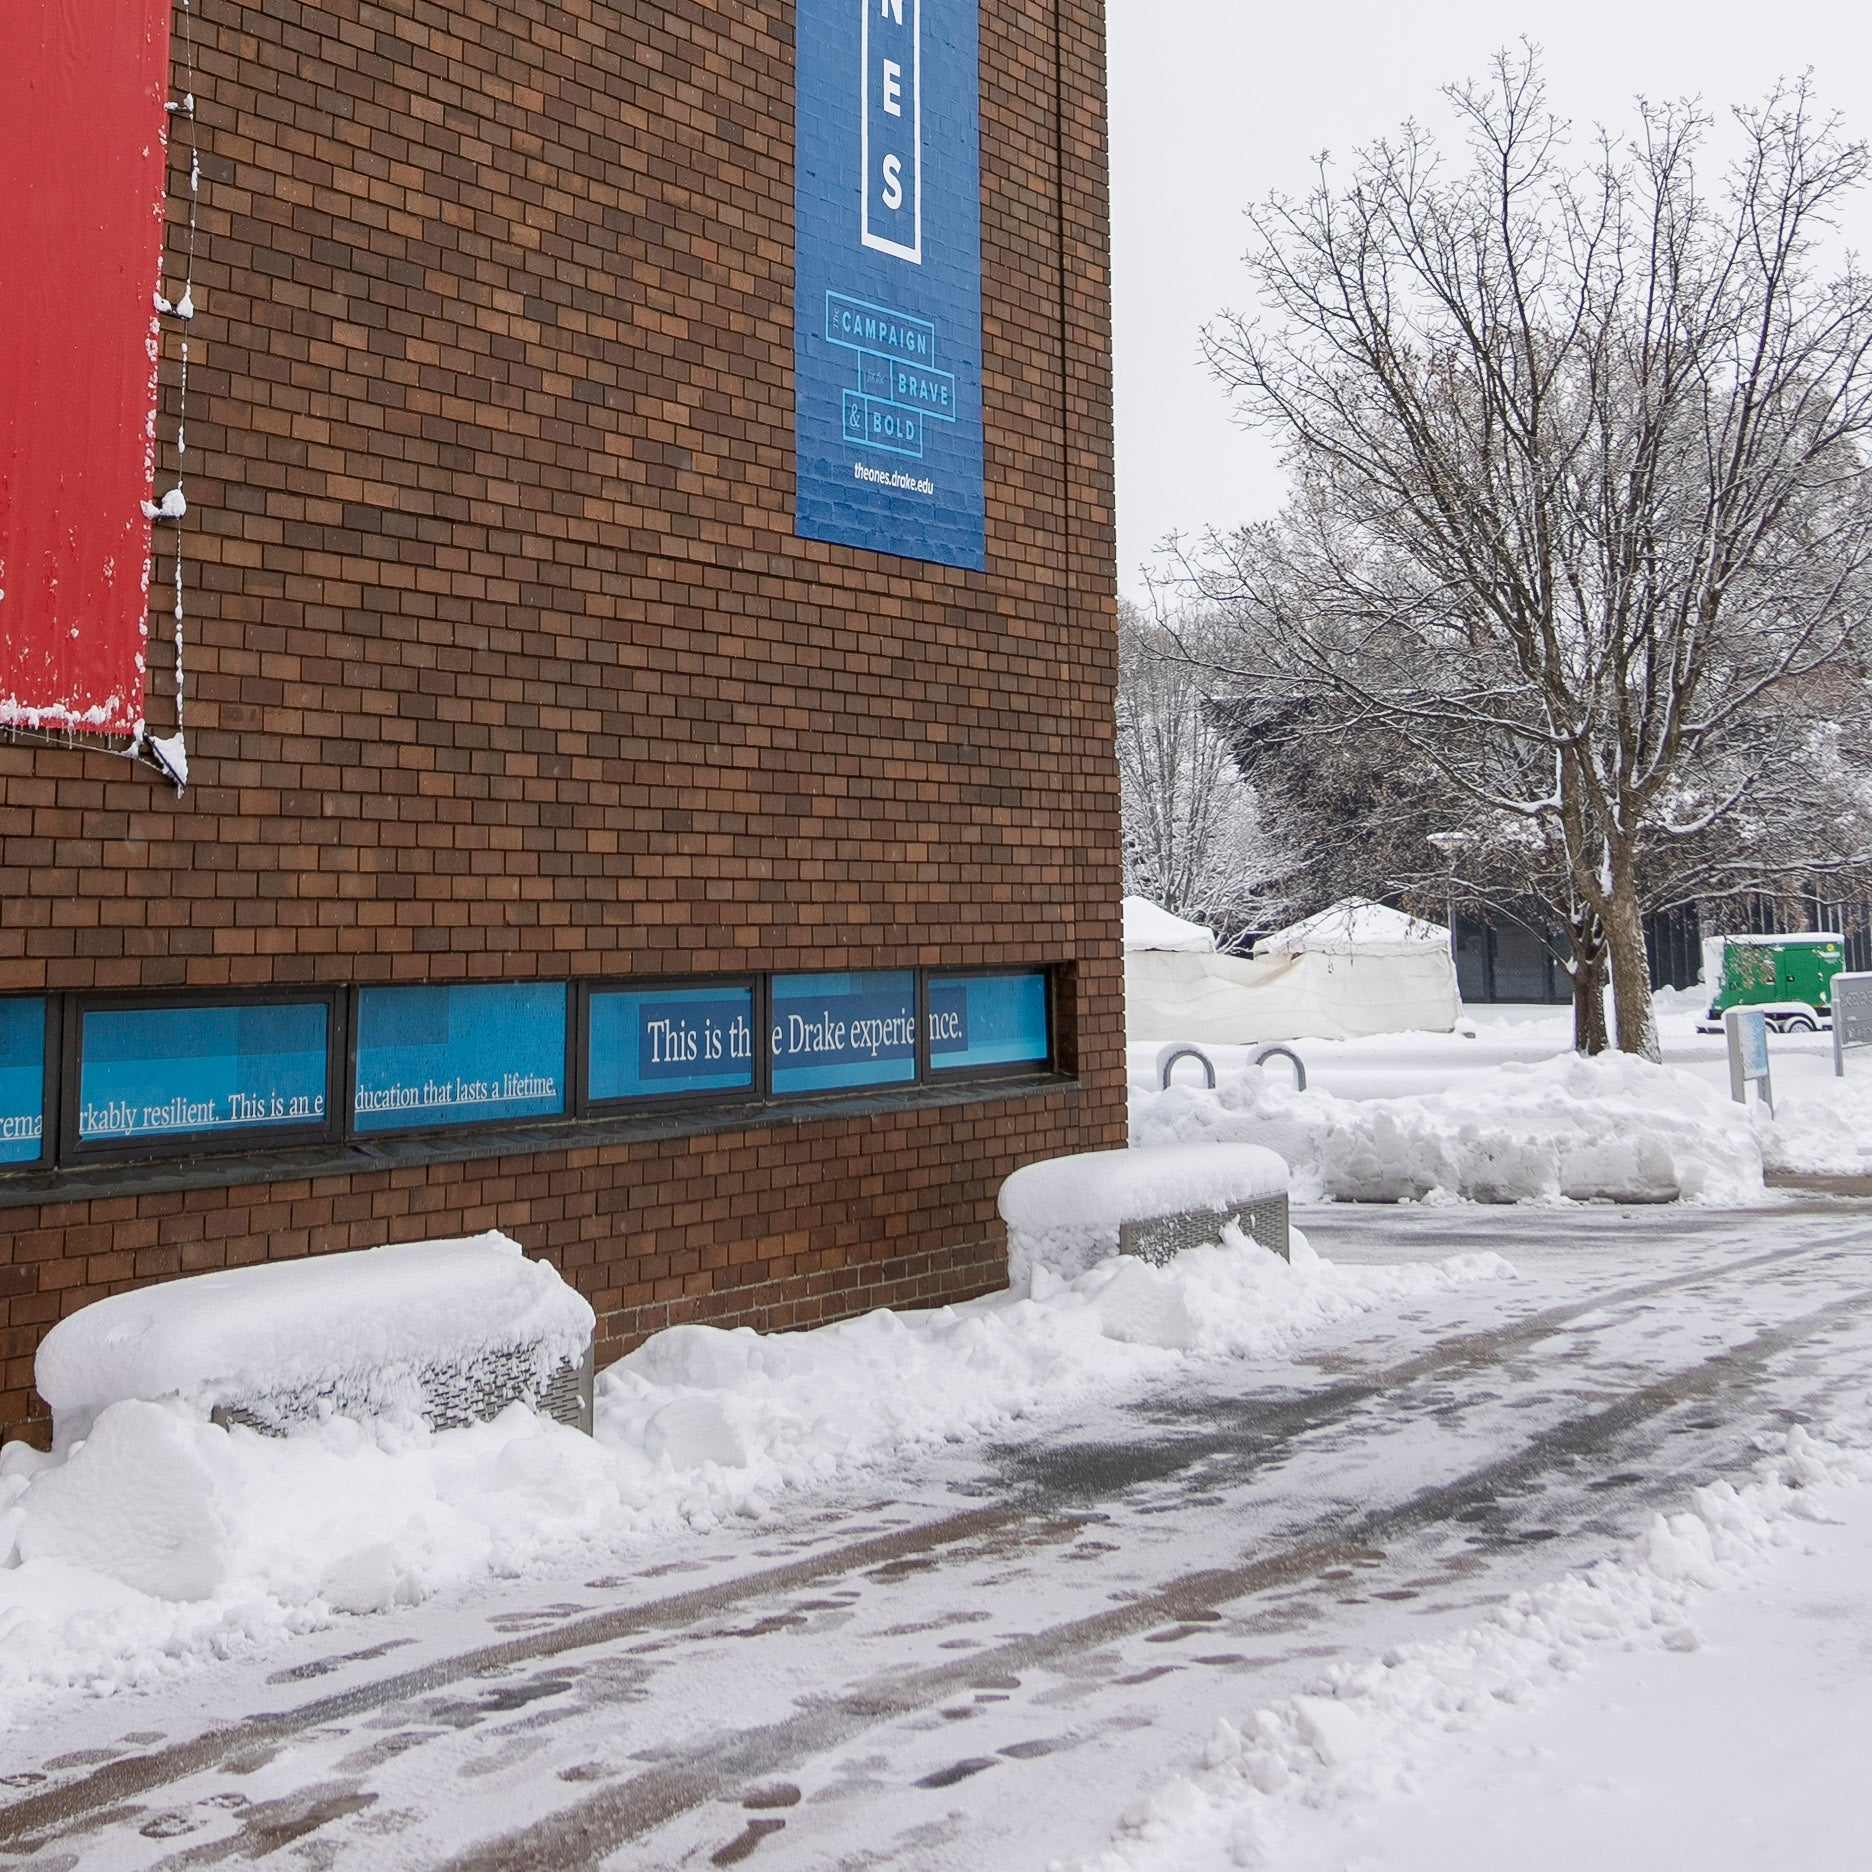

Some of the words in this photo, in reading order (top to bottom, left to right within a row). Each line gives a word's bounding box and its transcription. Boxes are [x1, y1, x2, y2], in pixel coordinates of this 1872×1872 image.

[842, 311, 927, 355] CAMPAIGN
[898, 373, 949, 406] BRAVE
[849, 403, 860, 428] &
[873, 412, 915, 440] BOLD
[854, 462, 934, 495] theones.drake.edu
[648, 1018, 698, 1063] This
[705, 1020, 724, 1059] is
[789, 1012, 845, 1054] Drake
[423, 1081, 452, 1105] that
[456, 1079, 489, 1103] lasts
[492, 1084, 500, 1100] a
[503, 1074, 557, 1098] lifetime.
[143, 1098, 219, 1128] resilient.
[227, 1093, 265, 1118] This
[270, 1092, 285, 1116] is
[289, 1099, 310, 1115] an
